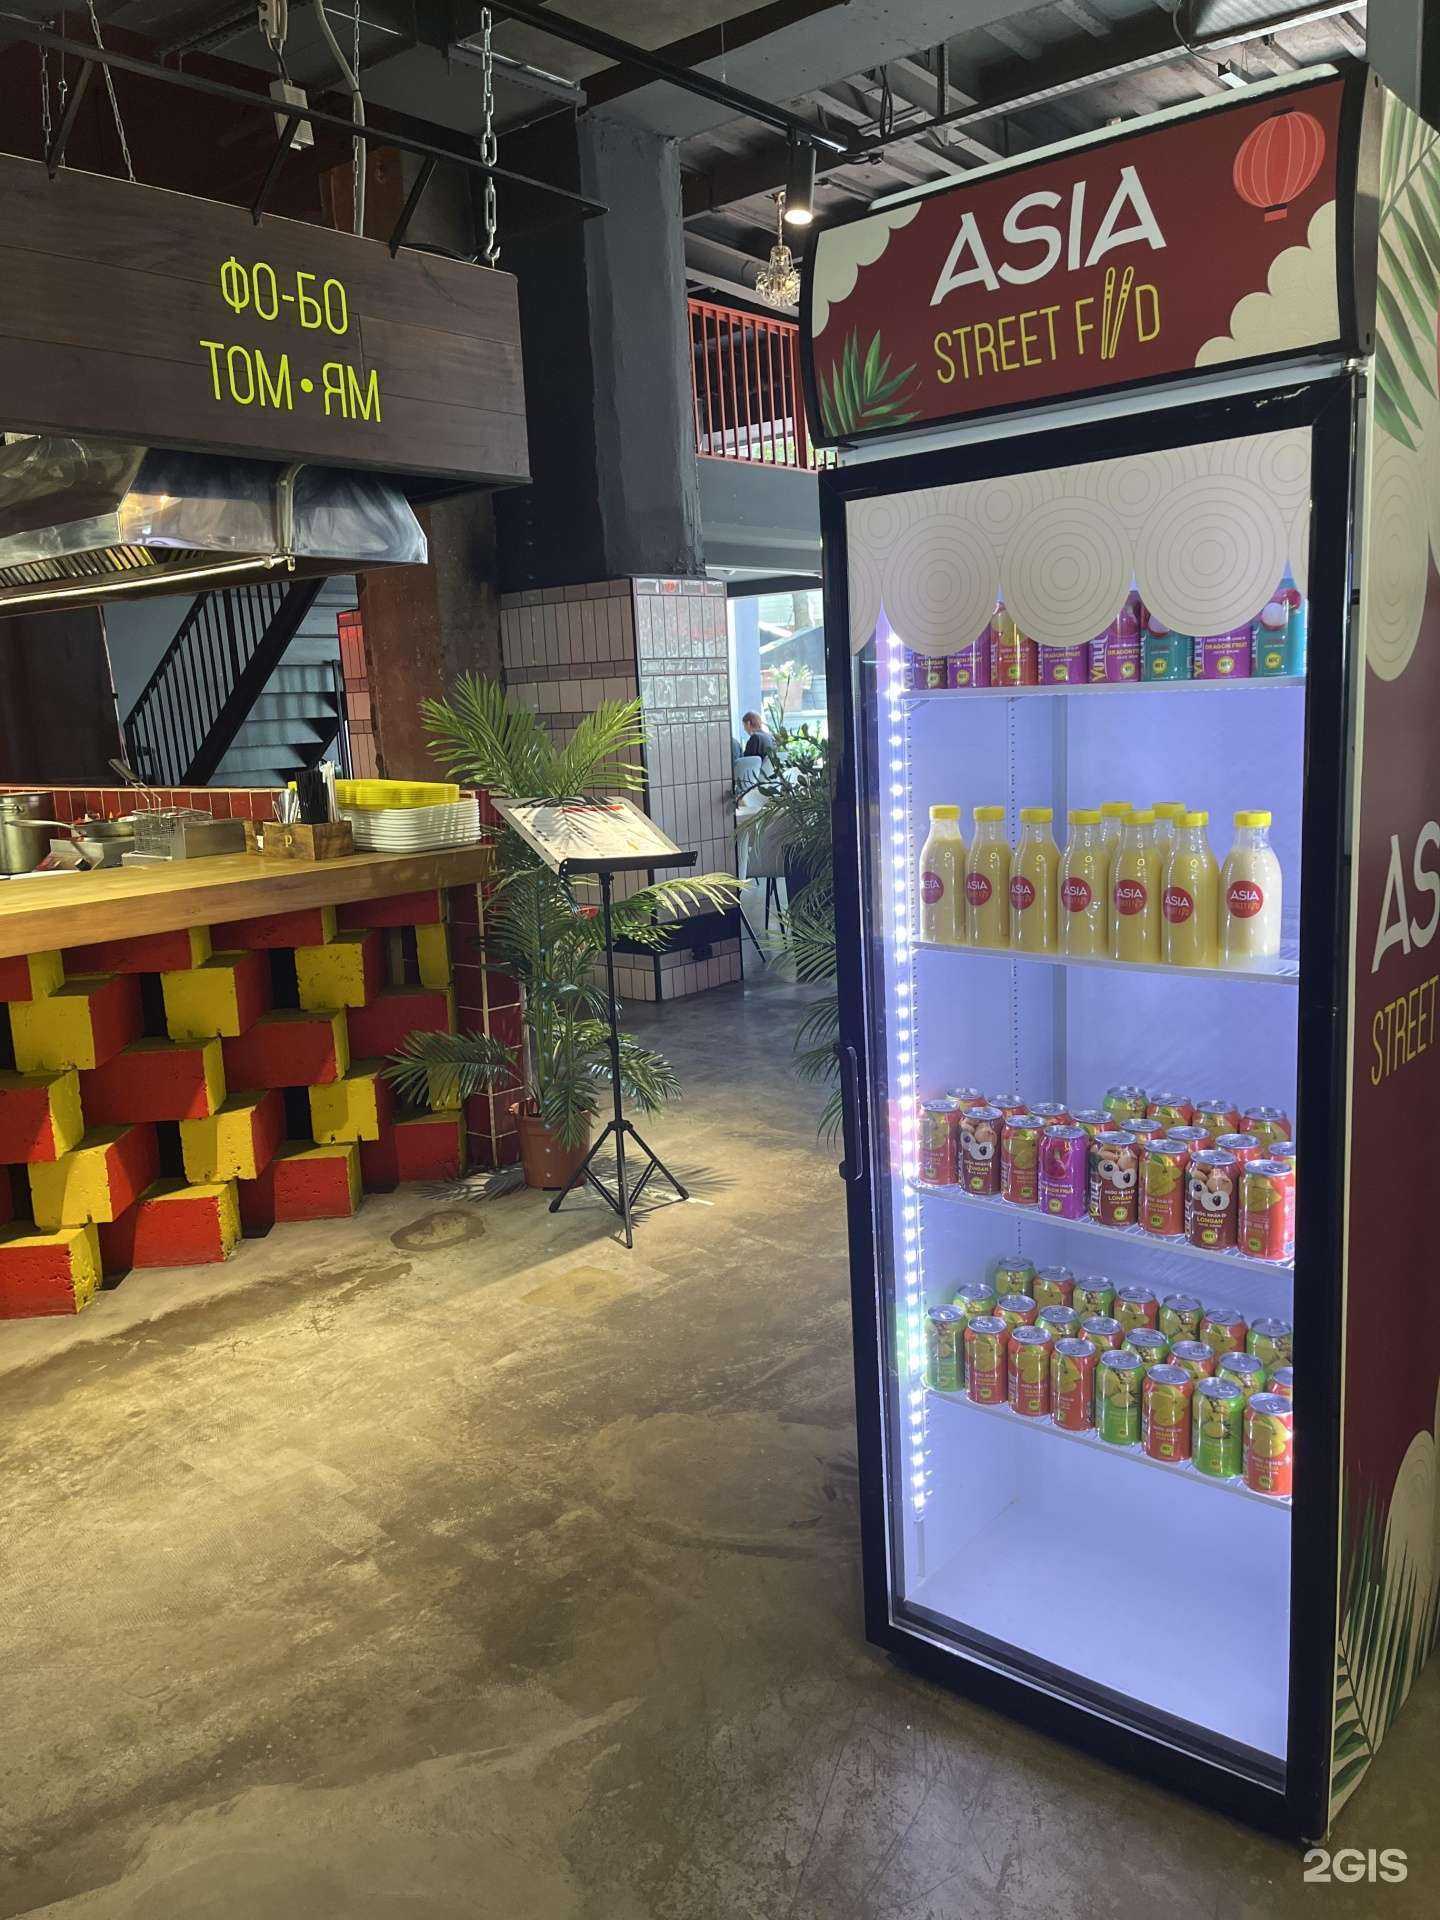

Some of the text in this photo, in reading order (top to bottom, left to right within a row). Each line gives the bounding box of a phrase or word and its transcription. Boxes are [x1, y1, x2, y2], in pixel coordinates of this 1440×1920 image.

[929, 165, 1167, 307] ASIA
[220, 256, 348, 335] ФО-БО
[934, 304, 1061, 384] STREET
[1063, 886, 1088, 896] ASIA
[1116, 888, 1143, 899] ASIA
[1165, 895, 1190, 907] ASIA
[1230, 889, 1260, 901] ASIA
[1370, 974, 1439, 1086] STREET
